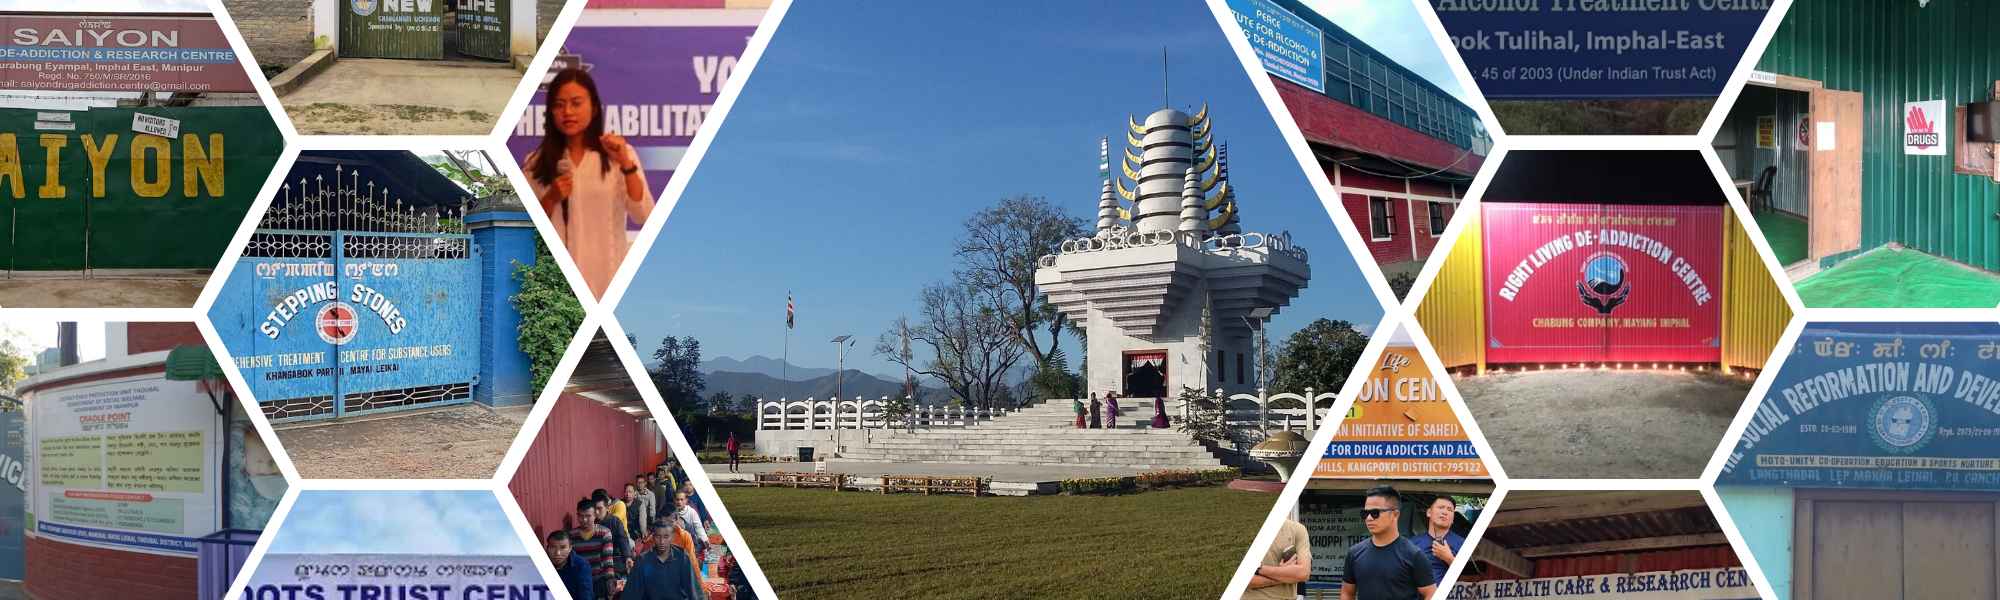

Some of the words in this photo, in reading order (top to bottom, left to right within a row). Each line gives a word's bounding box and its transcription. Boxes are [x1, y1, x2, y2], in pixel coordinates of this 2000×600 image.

[383, 0, 433, 12] NEW
[13, 27, 178, 48] SAIYON
[1256, 22, 1274, 38] FOR
[1494, 30, 1580, 52] Tulihal,
[1586, 30, 1725, 54] Imphal-East
[94, 50, 102, 59] &
[106, 50, 177, 60] RESEARCH
[181, 51, 233, 60] CENTRE
[95, 63, 130, 73] Imphal
[133, 63, 158, 72] East,
[162, 64, 204, 73] Manipur
[1481, 67, 1499, 80] 45
[1503, 66, 1517, 80] of
[1520, 67, 1553, 80] 2003
[1558, 66, 1602, 82] (Under
[1607, 67, 1648, 80] Indian
[1653, 66, 1688, 79] Trust
[1690, 66, 1717, 81] Act)
[1907, 134, 1937, 145] DRUGS
[1499, 262, 1534, 302] RIGHT
[1530, 235, 1574, 268] LIVING
[1671, 256, 1712, 306] CENTRE
[260, 281, 337, 340] STEPPING
[351, 283, 406, 335] STONES
[1577, 317, 1622, 329] COMPANY,
[279, 351, 325, 367] TREATMENT
[340, 349, 368, 363] CENTRE
[372, 348, 386, 360] FOR
[388, 345, 428, 360] SUBSTANCE
[430, 343, 452, 356] USERS
[1380, 352, 1410, 373] Life
[316, 368, 334, 378] PART
[351, 366, 372, 375] MAYAI
[1782, 362, 1911, 416] REFORMATION
[1912, 363, 1954, 395] AND
[1352, 424, 1404, 437] INITIATIVE
[1408, 424, 1421, 437] OF
[1331, 444, 1351, 456] FOR
[1354, 444, 1383, 456] DRUG
[1385, 444, 1429, 456] ADDICTS
[1432, 444, 1453, 456] AND
[1347, 462, 1400, 473] KANGPOKPI
[338, 584, 450, 600] TRUST
[1495, 580, 1551, 599] HEALTH
[1554, 576, 1595, 596] CARE
[1600, 577, 1611, 593] &
